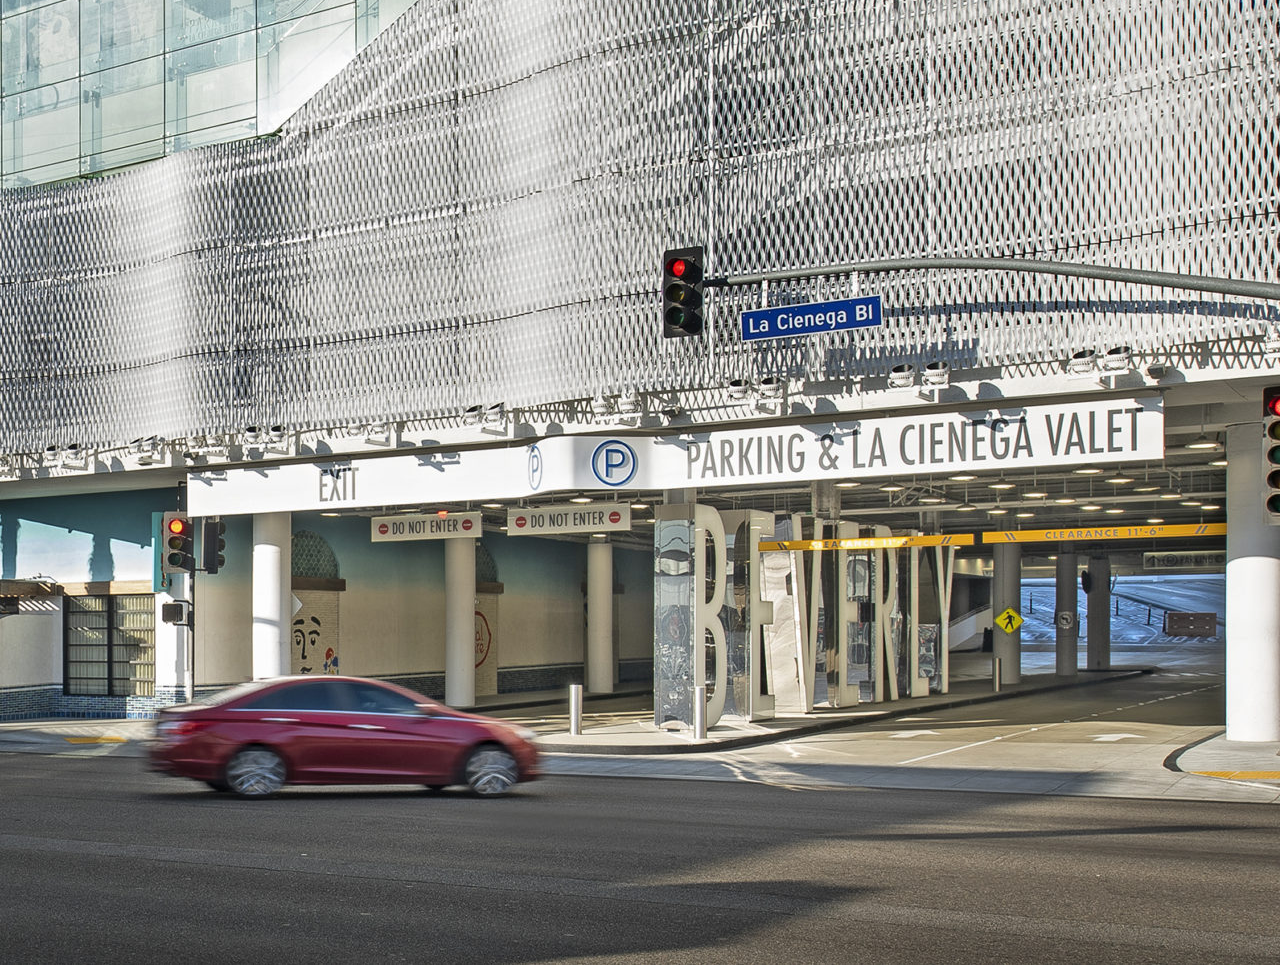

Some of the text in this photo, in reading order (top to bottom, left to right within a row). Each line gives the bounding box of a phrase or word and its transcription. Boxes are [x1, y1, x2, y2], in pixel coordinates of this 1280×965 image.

[749, 317, 769, 334] La
[777, 309, 848, 330] Cienega
[687, 407, 1144, 480] PARKING & LA CIENEGA VALET
[319, 466, 359, 502] EXIT
[392, 519, 458, 535] DO NOT ENTER
[530, 510, 605, 528] DO NOT ENTER
[1045, 528, 1119, 540] CLEARANCE
